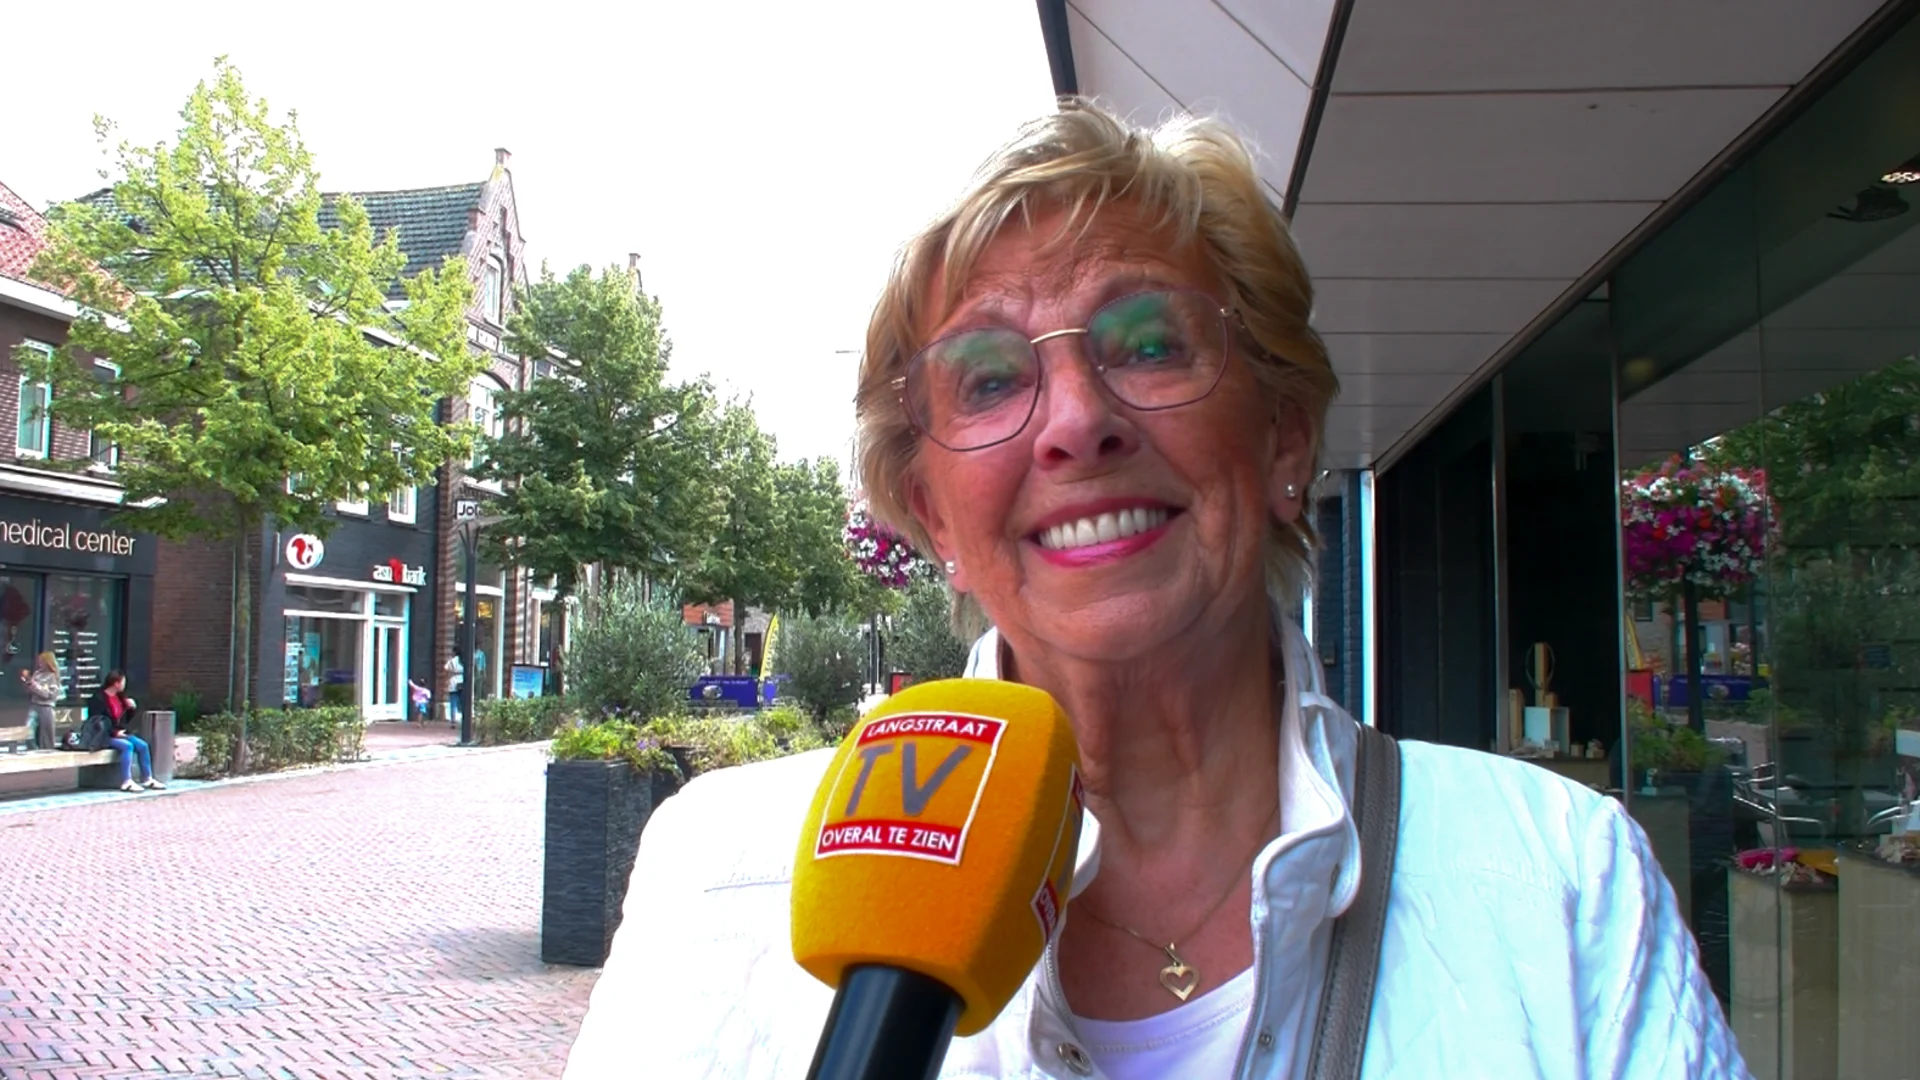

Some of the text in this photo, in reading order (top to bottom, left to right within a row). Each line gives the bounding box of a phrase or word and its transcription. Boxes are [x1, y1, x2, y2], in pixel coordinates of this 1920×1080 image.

[75, 529, 136, 555] center
[867, 718, 987, 738] LANGSTRAAT
[845, 741, 973, 817] TV
[822, 826, 956, 852] OVERAL TE ZIEN
